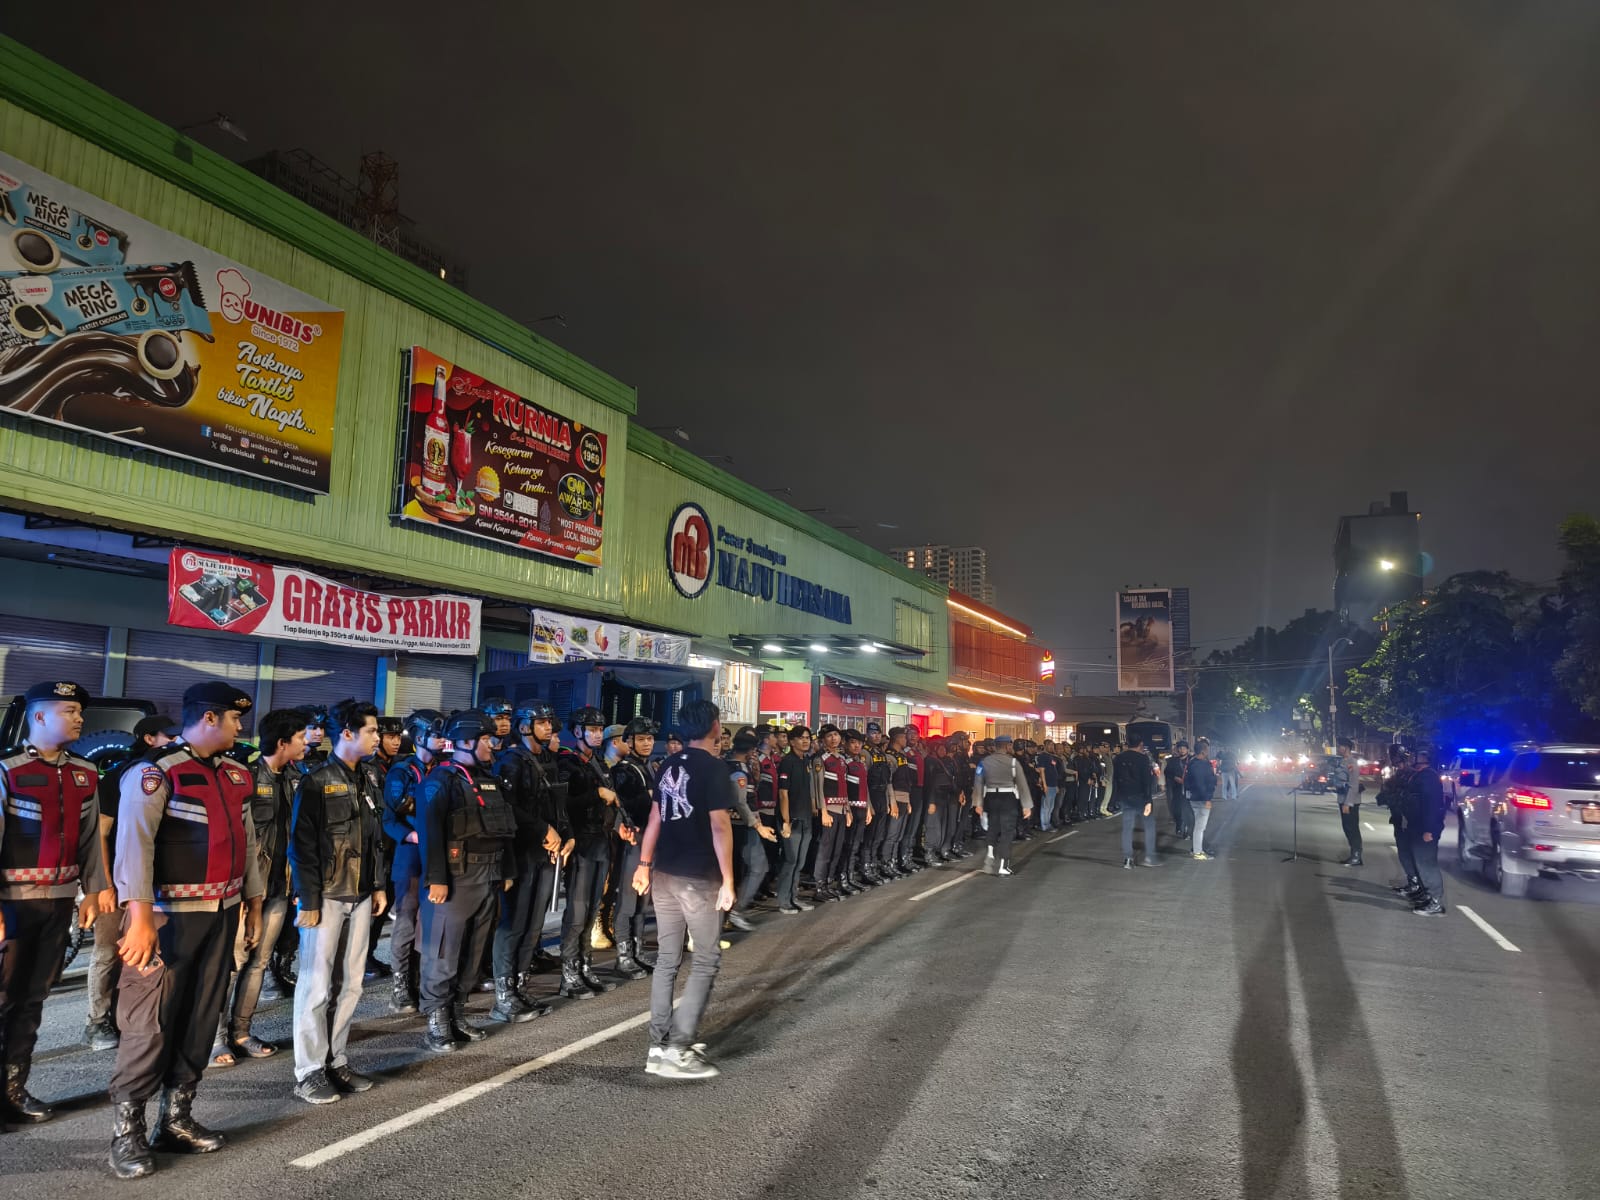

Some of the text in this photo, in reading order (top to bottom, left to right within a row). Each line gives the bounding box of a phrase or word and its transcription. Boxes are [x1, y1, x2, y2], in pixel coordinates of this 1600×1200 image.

[27, 192, 69, 218] MEGA
[35, 207, 67, 228] RING
[64, 280, 113, 306] MEGA
[79, 295, 117, 318] RING
[99, 312, 128, 326] CHOCOLATE
[244, 300, 314, 343] UNIBIS
[252, 326, 298, 351] Since 1972
[238, 341, 304, 383] Asiknya
[236, 364, 294, 401] Tartlet
[217, 388, 247, 408] bikin
[493, 389, 572, 451] KURNIA
[484, 440, 534, 460] Kesegaran
[503, 461, 543, 480] Keluarga
[479, 504, 493, 519] SNI
[558, 492, 592, 512] AWARDS
[716, 549, 774, 601] MAJU
[282, 573, 471, 640] GRATIS PARKIR
[283, 625, 297, 634] Tiap
[298, 626, 321, 638] Belanja
[322, 630, 330, 638] Rp
[354, 635, 369, 643] Maju
